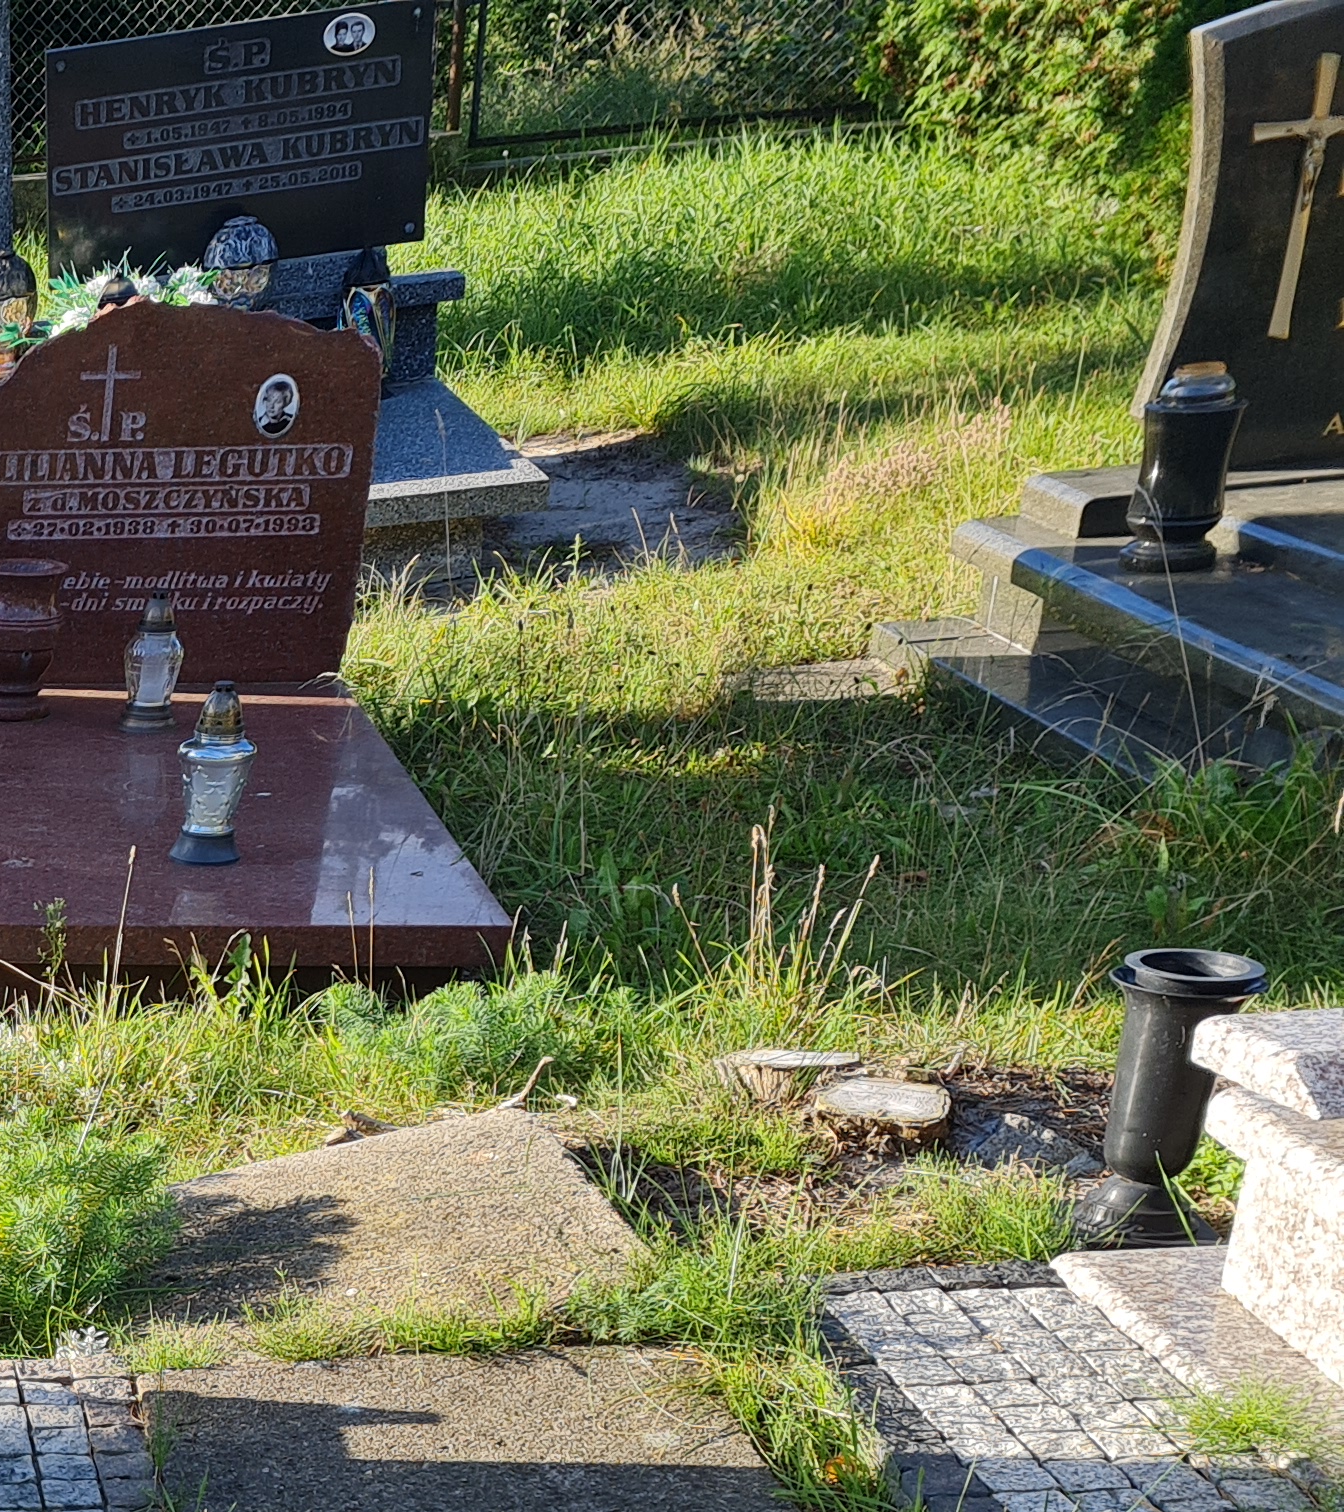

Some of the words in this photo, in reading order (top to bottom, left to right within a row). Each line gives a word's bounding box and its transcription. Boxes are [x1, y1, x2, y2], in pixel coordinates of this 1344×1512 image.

[79, 82, 231, 128] HENRYK
[244, 58, 400, 102] KUBRYN
[55, 141, 268, 193] STANISŁAWA
[280, 118, 423, 161] KUBRYN
[173, 446, 353, 480] LEGUTKO
[246, 568, 333, 592] kwiaty
[213, 592, 325, 616] rozpaczy.
